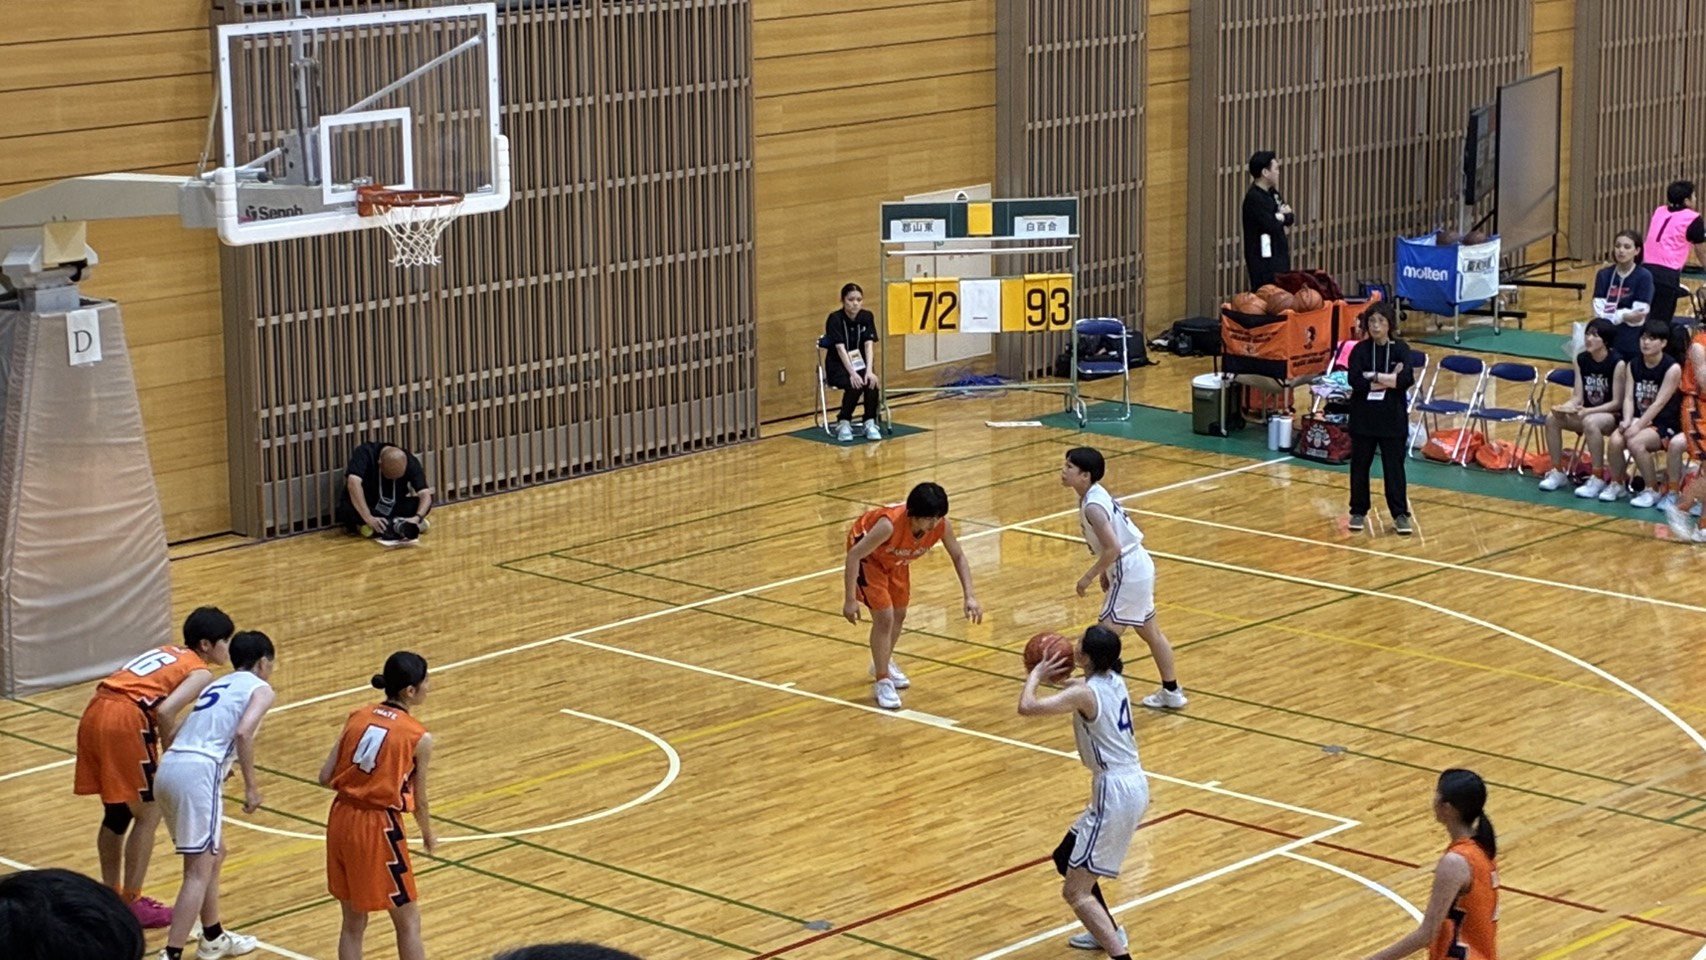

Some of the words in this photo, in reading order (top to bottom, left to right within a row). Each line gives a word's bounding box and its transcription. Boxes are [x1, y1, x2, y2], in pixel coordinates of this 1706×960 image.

[1026, 221, 1058, 232] 白百合
[1655, 215, 1673, 243] 1
[1403, 265, 1449, 281] molten
[913, 291, 957, 330] 72
[1026, 287, 1070, 327] 93
[74, 329, 93, 354] D
[122, 648, 177, 677] 16
[193, 683, 231, 712] 5
[1117, 697, 1134, 736] 4
[352, 724, 390, 774] 4
